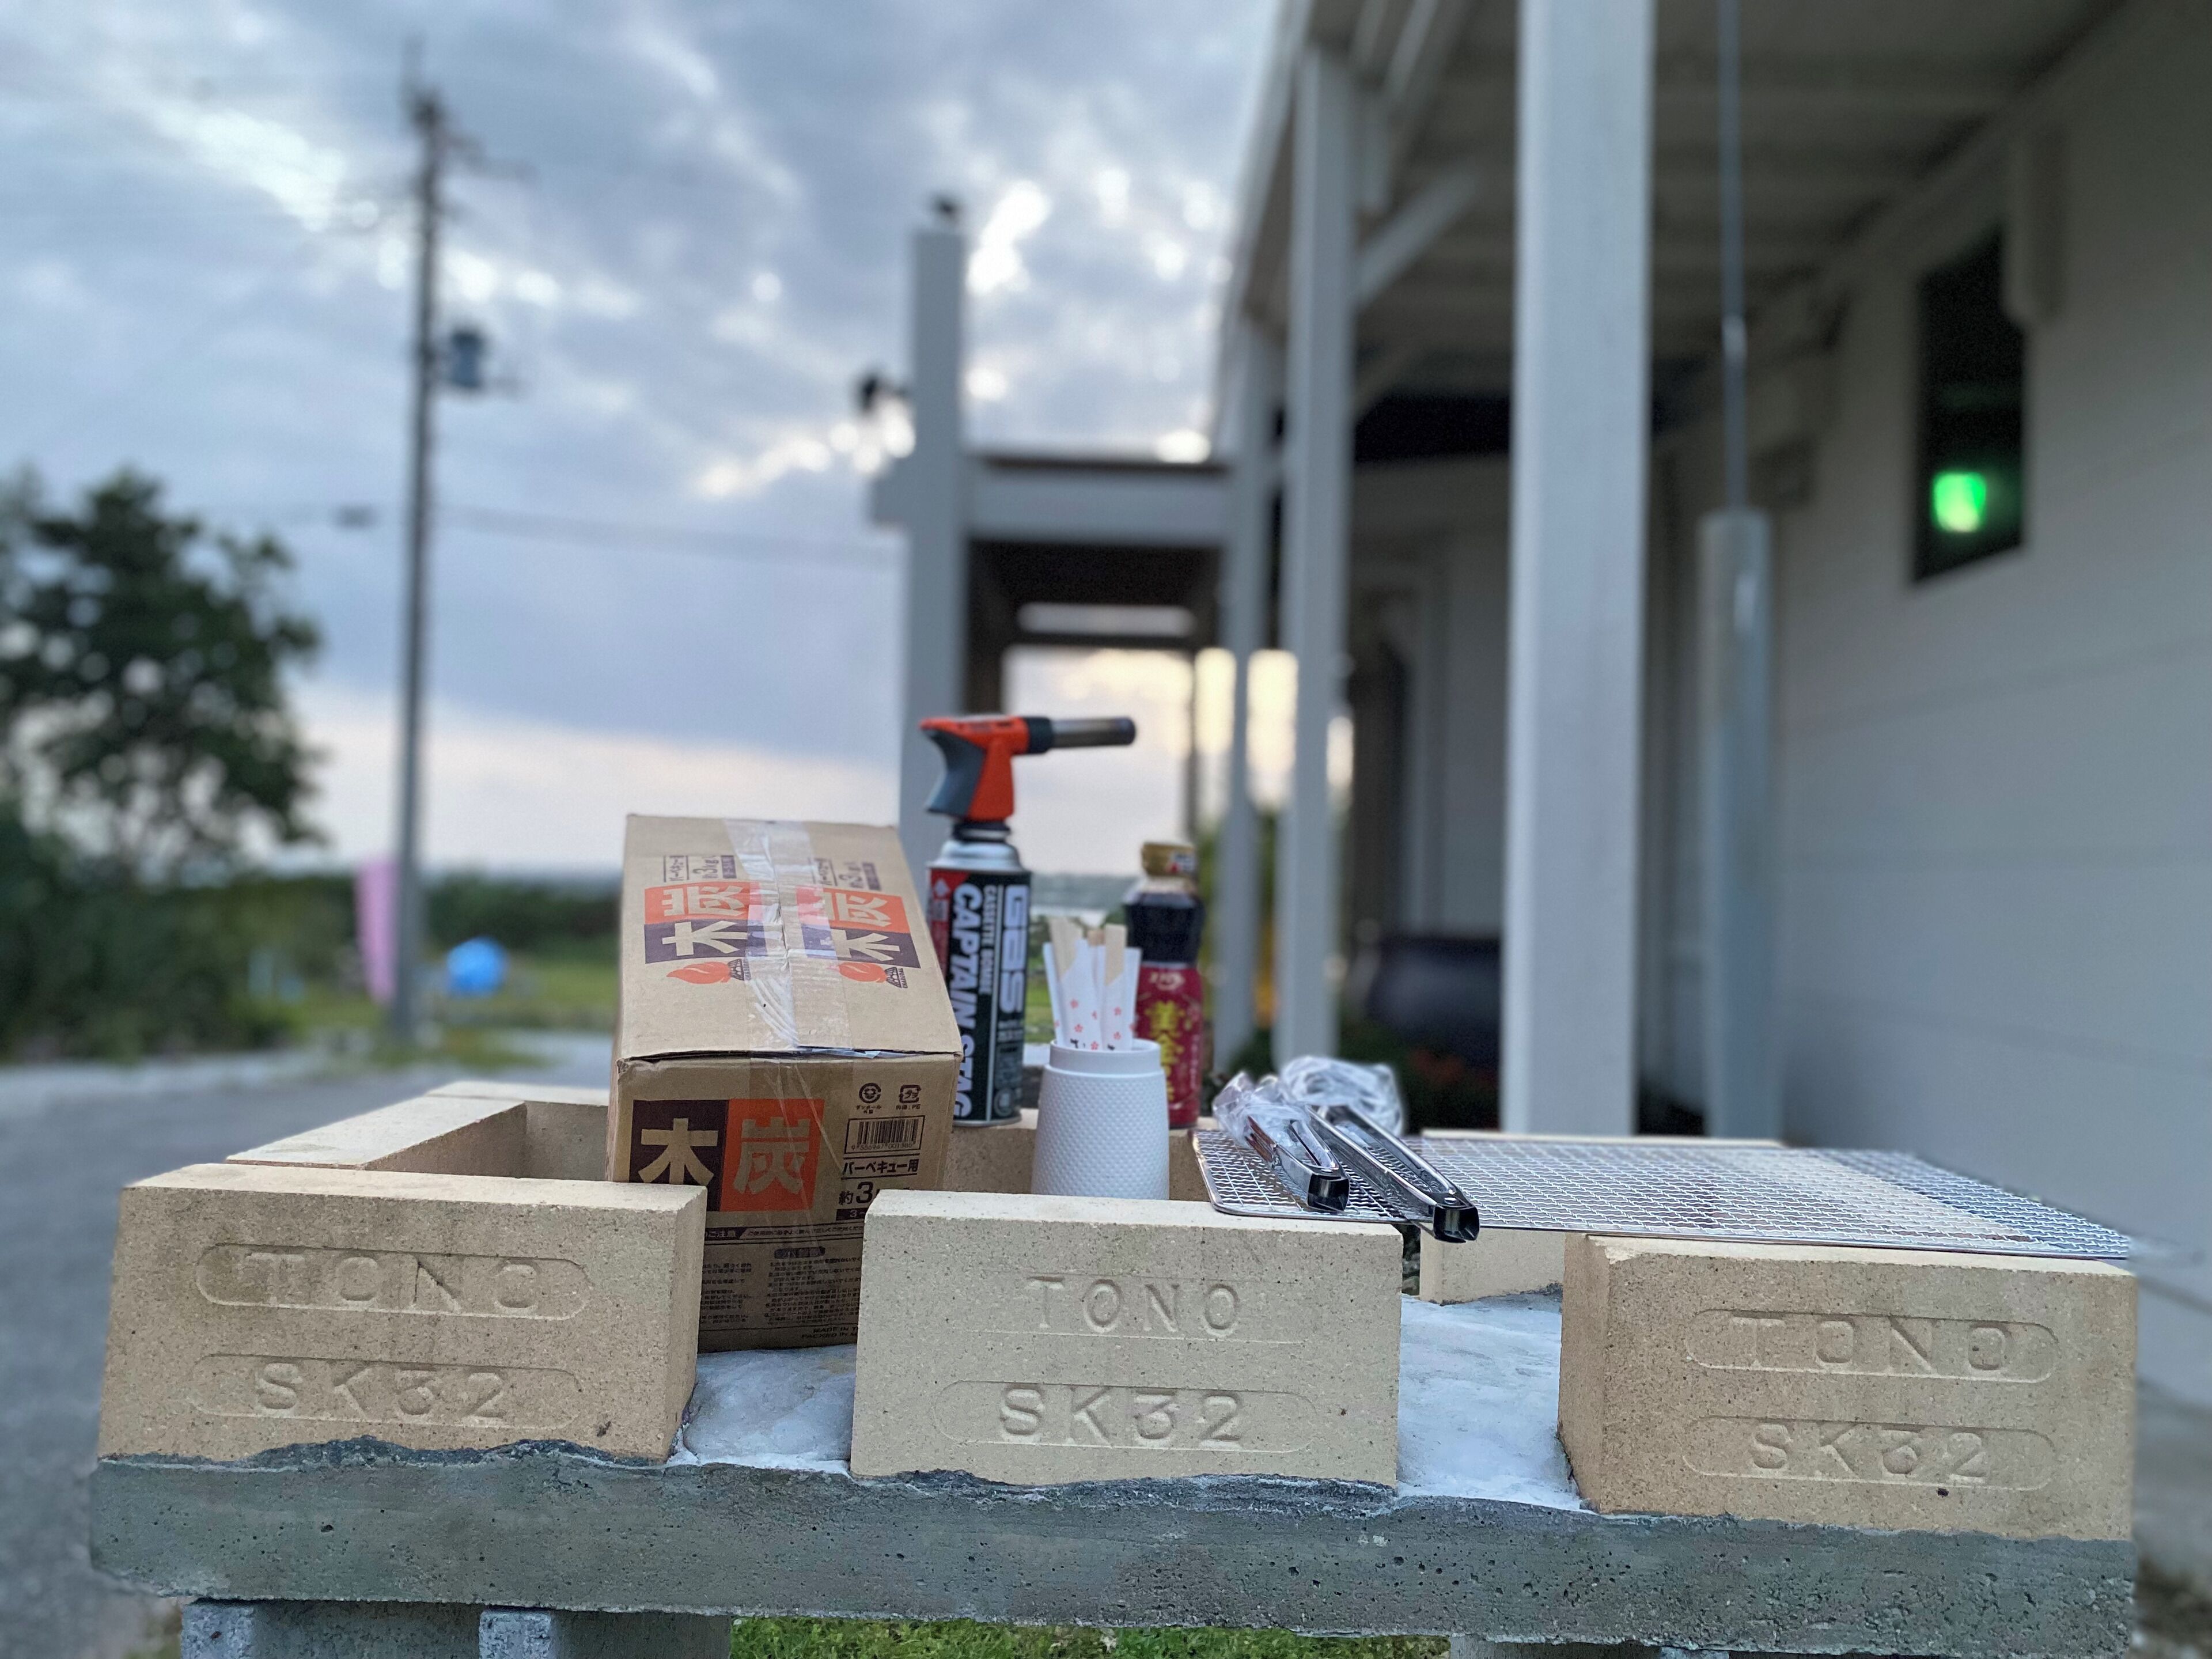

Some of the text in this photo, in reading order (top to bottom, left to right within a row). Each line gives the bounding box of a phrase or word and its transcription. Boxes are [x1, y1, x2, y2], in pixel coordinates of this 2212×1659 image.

[662, 885, 748, 957] 木炭
[813, 892, 901, 961] 木炭
[951, 883, 983, 1030] CAPTAIN
[637, 1118, 810, 1196] 木炭
[842, 1159, 919, 1175] バーベキュー用
[243, 1251, 539, 1315] TONO
[1025, 1274, 1241, 1338] TONO
[1730, 1310, 2010, 1376] TONO
[253, 1360, 507, 1421] SK32
[997, 1382, 1244, 1449] SK32
[1751, 1419, 1987, 1484] SK32
